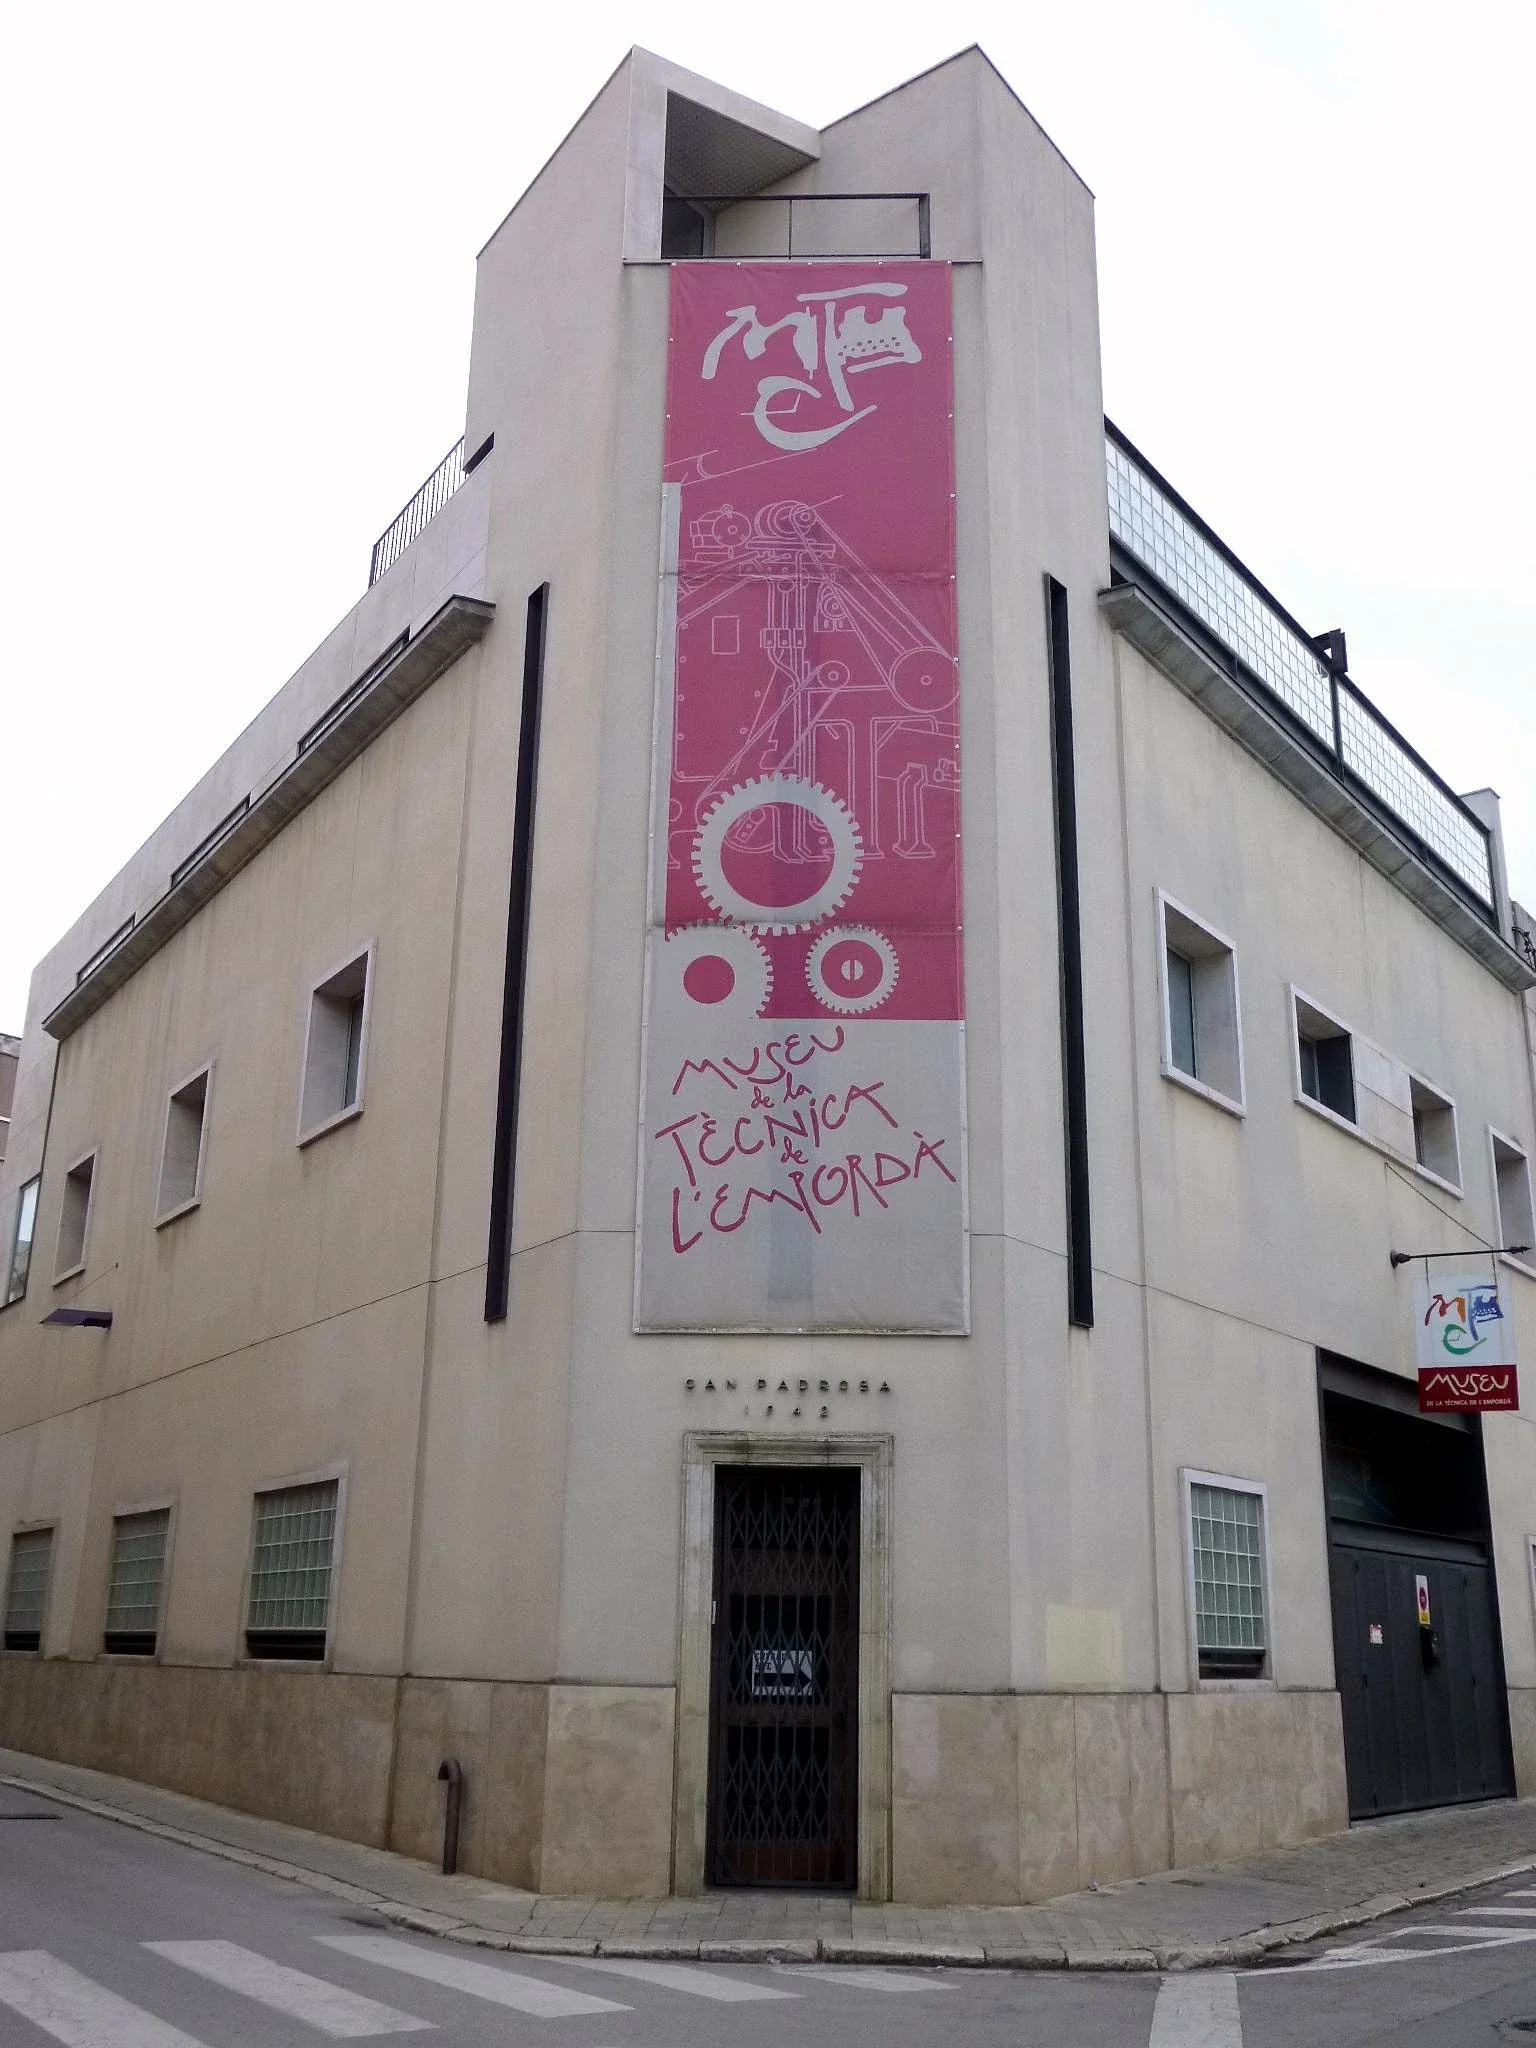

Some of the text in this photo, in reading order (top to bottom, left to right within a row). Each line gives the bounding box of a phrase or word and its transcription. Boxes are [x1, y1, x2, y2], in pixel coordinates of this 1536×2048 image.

[671, 1025, 845, 1095] MUSEU
[751, 1071, 812, 1108] de la
[655, 1081, 898, 1186] TÈCNICA
[780, 1136, 809, 1164] de
[757, 1378, 891, 1394] PADROSA
[1425, 1373, 1510, 1396] MUSEU
